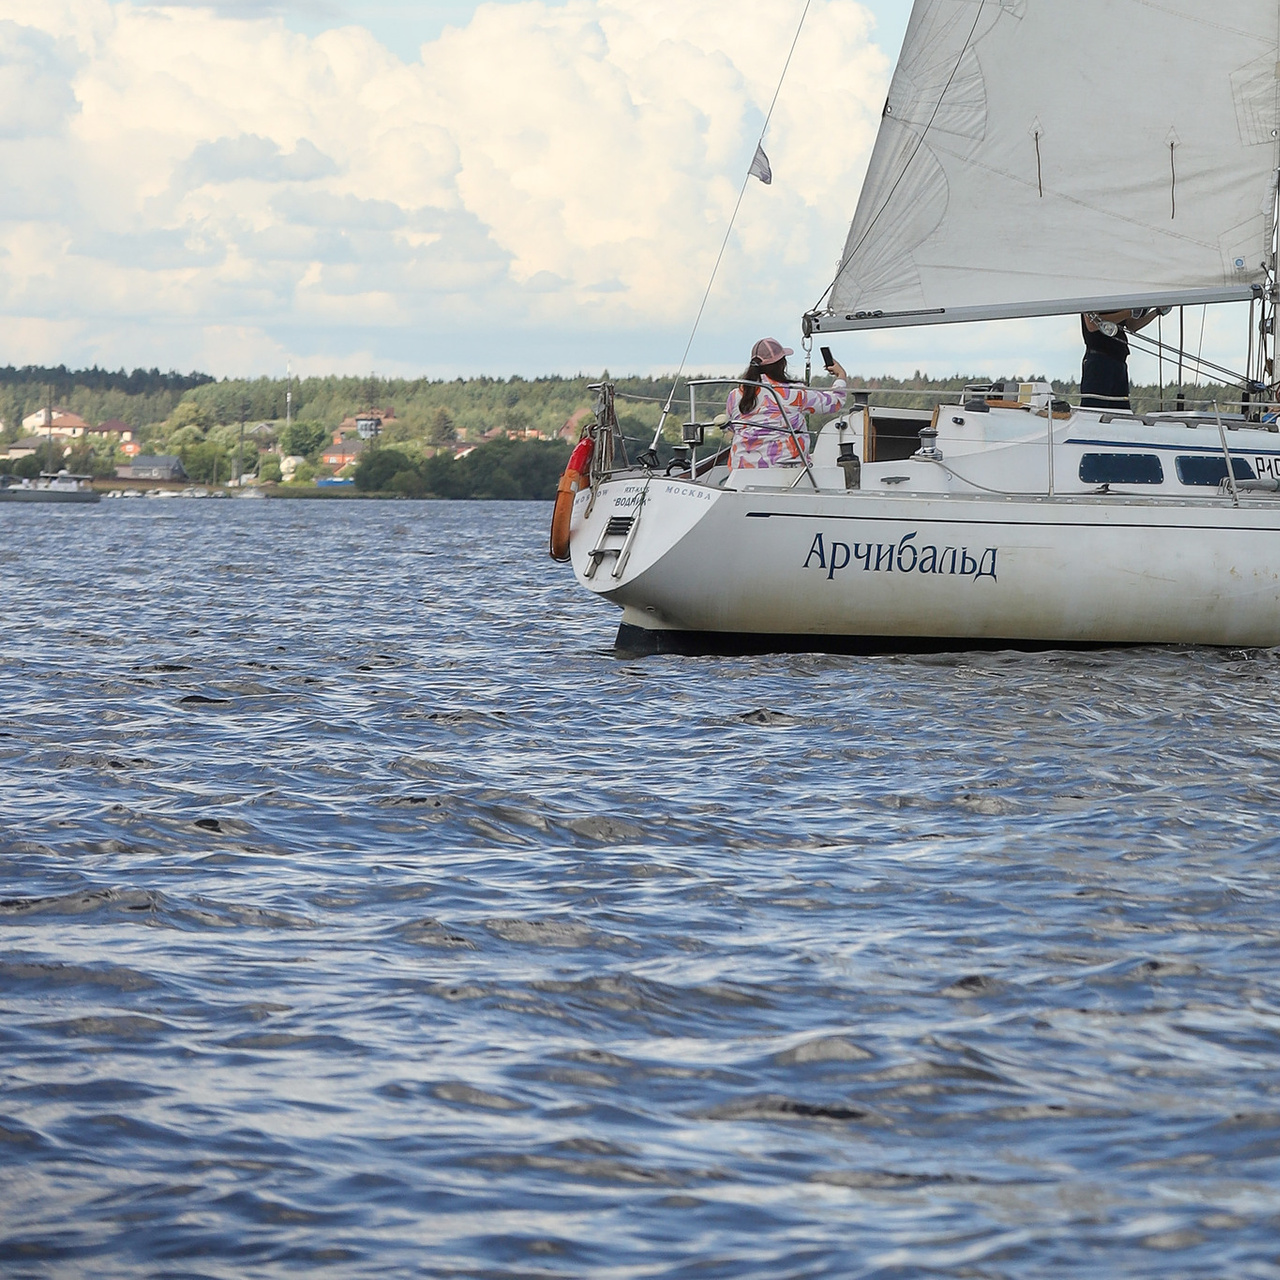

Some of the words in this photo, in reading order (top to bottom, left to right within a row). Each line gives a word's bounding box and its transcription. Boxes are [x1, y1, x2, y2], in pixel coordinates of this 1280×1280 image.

[575, 489, 609, 505] MOSOW
[624, 486, 650, 494] ЯХТ-КЛБ
[665, 485, 712, 501] МОСКВА
[802, 530, 998, 583] Арчибальд
